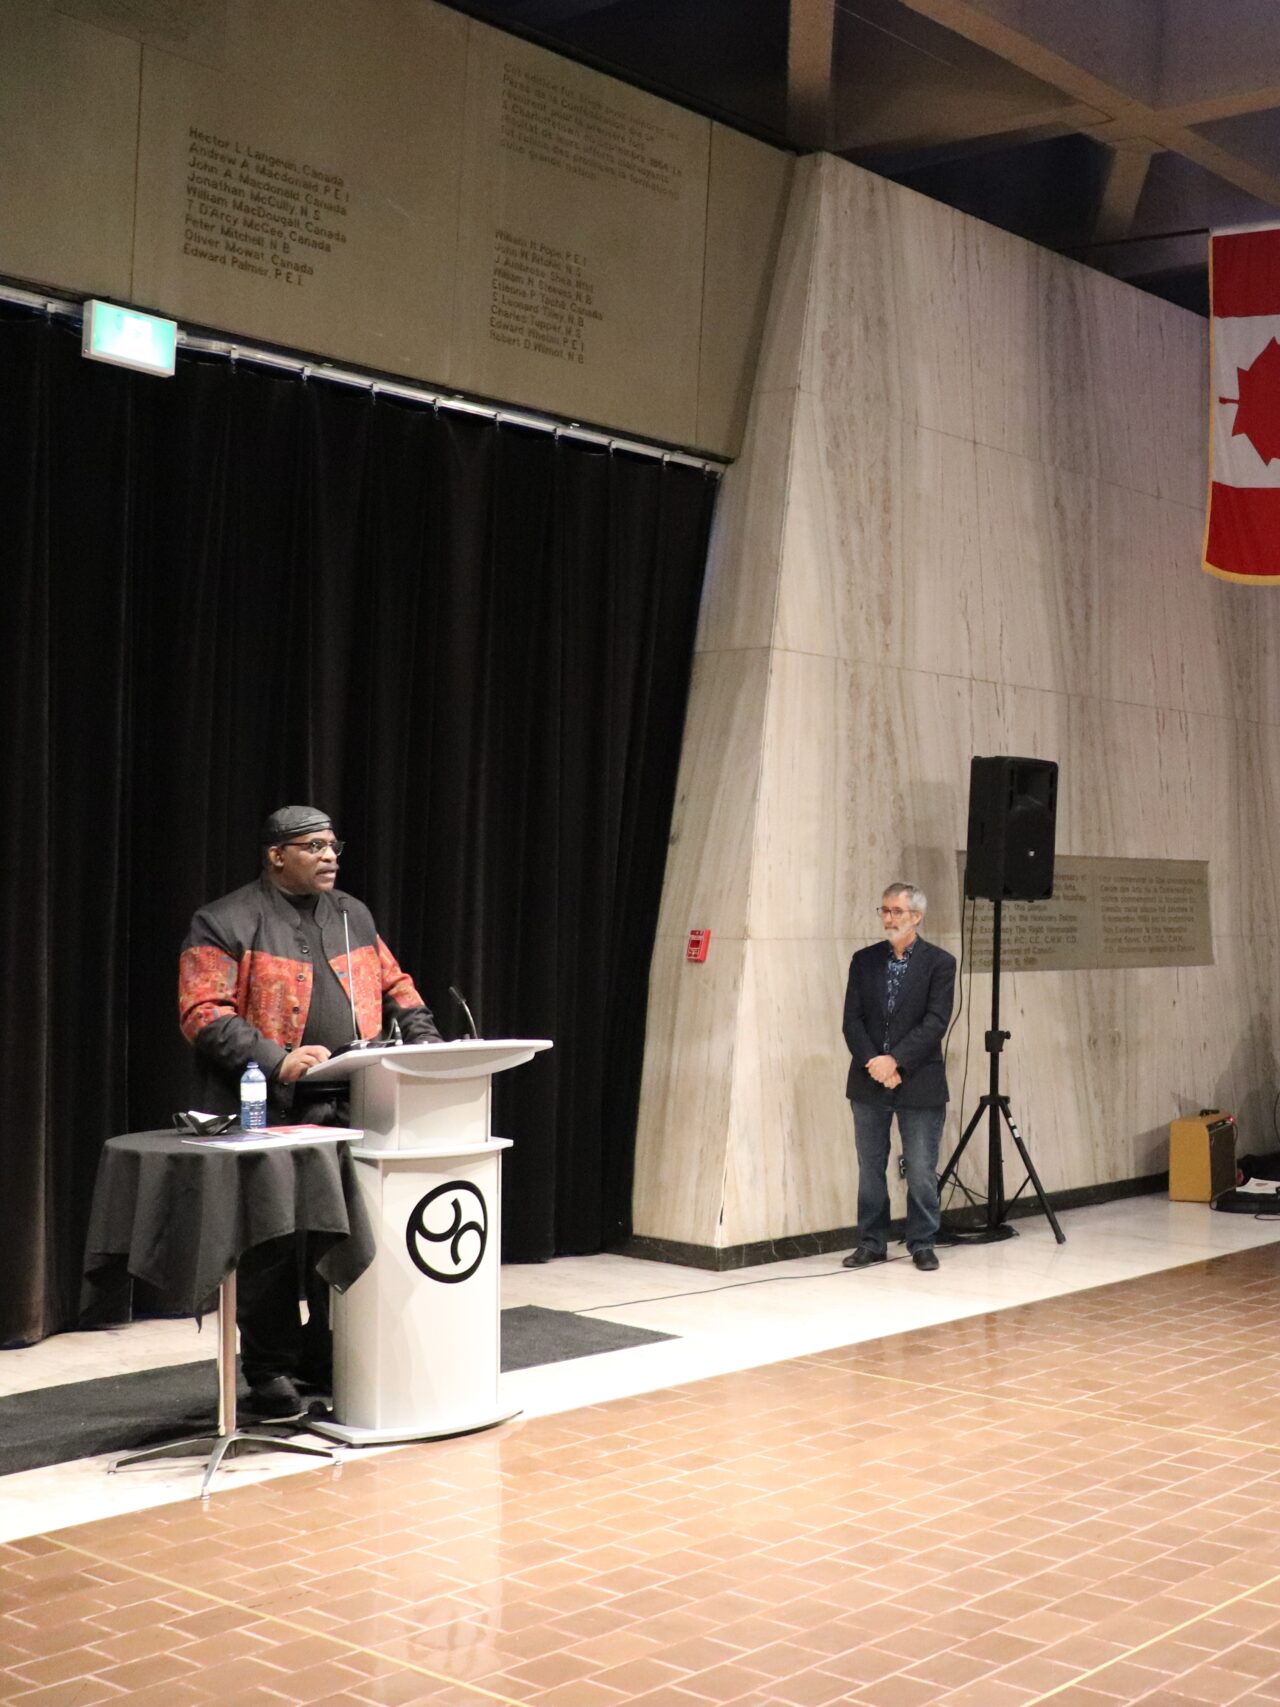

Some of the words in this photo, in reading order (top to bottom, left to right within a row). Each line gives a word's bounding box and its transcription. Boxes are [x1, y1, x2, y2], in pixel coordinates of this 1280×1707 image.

[189, 127, 229, 148] Hector
[188, 155, 217, 174] John
[189, 142, 235, 165] Andrew
[187, 170, 244, 197] Jonathan
[185, 213, 215, 232] Peter
[187, 185, 227, 206] William
[305, 222, 346, 243] Canada
[184, 228, 219, 248] Oliver
[271, 254, 313, 275] Canada
[289, 231, 331, 252] Canada
[183, 242, 225, 265] Edward
